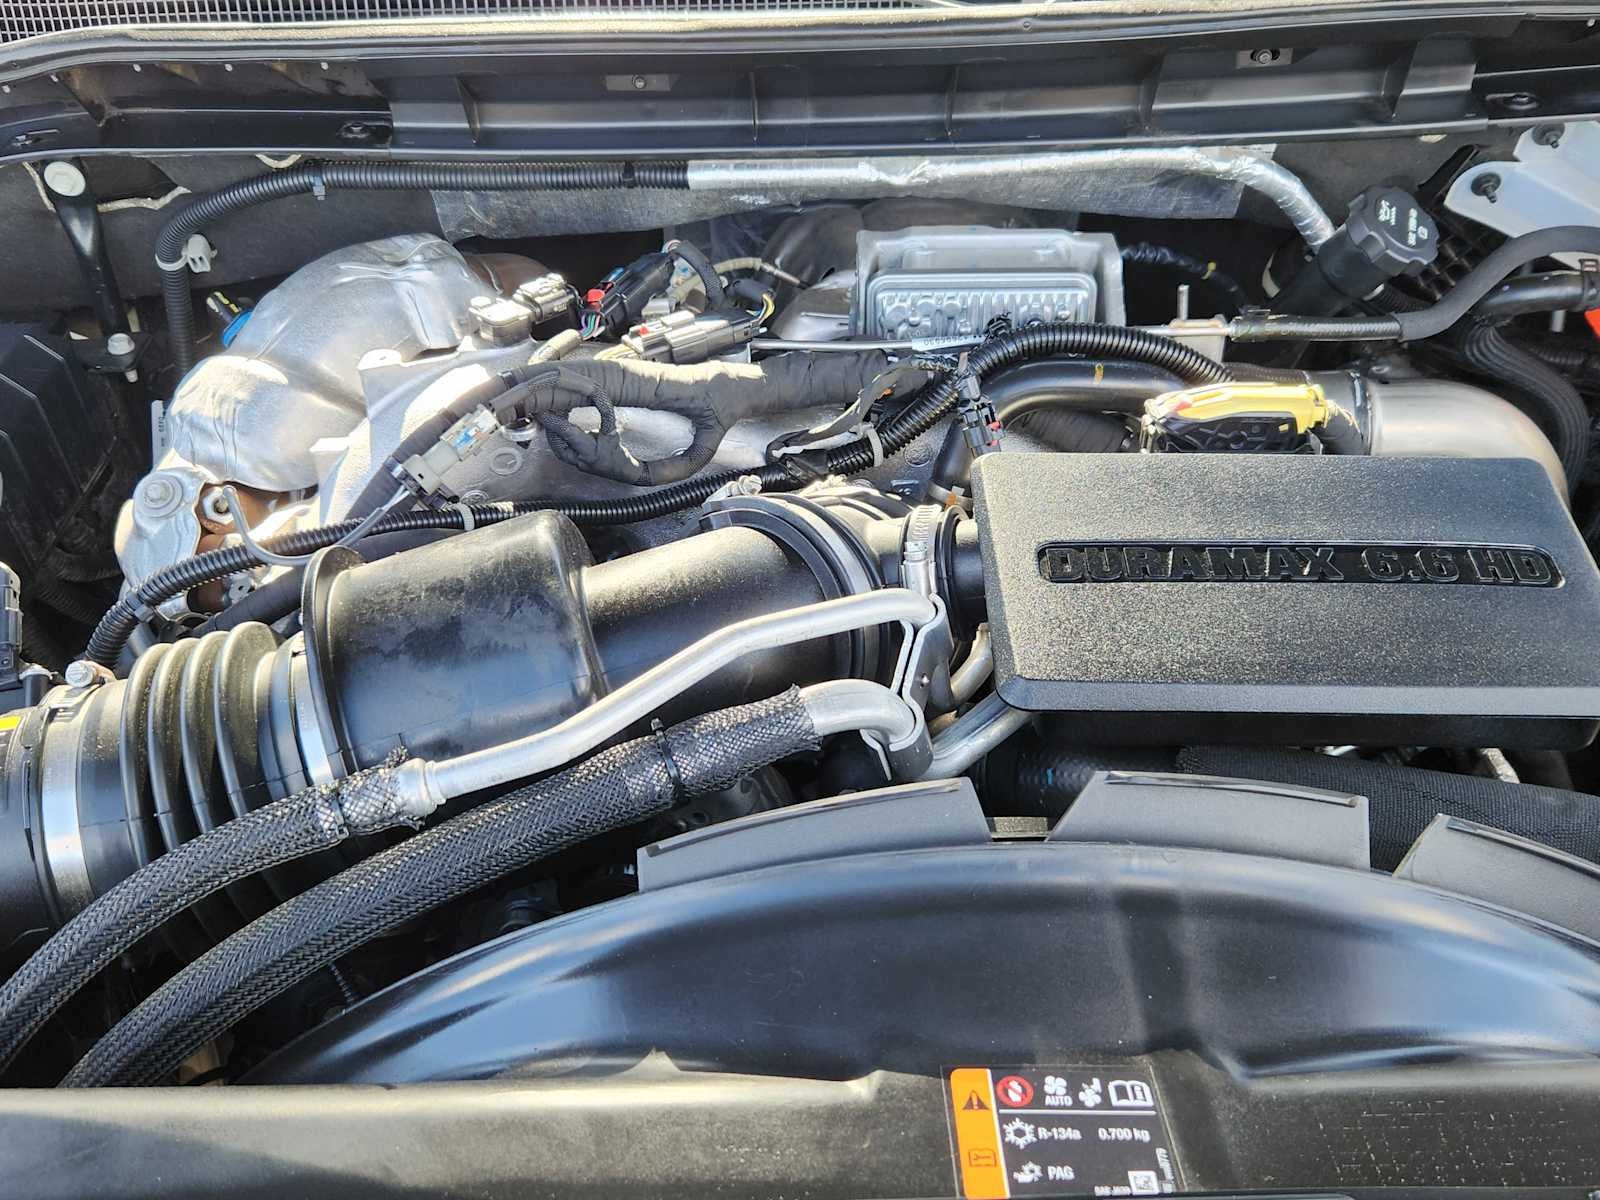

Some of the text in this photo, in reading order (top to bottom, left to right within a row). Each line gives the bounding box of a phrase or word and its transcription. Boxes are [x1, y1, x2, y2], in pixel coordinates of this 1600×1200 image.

[1046, 547, 1552, 584] DURAMAX 6.6 HD
[1045, 1095, 1073, 1107] AUTO
[1038, 1127, 1151, 1143] R-134a 0.700 kg
[1047, 1165, 1075, 1181] PAG
